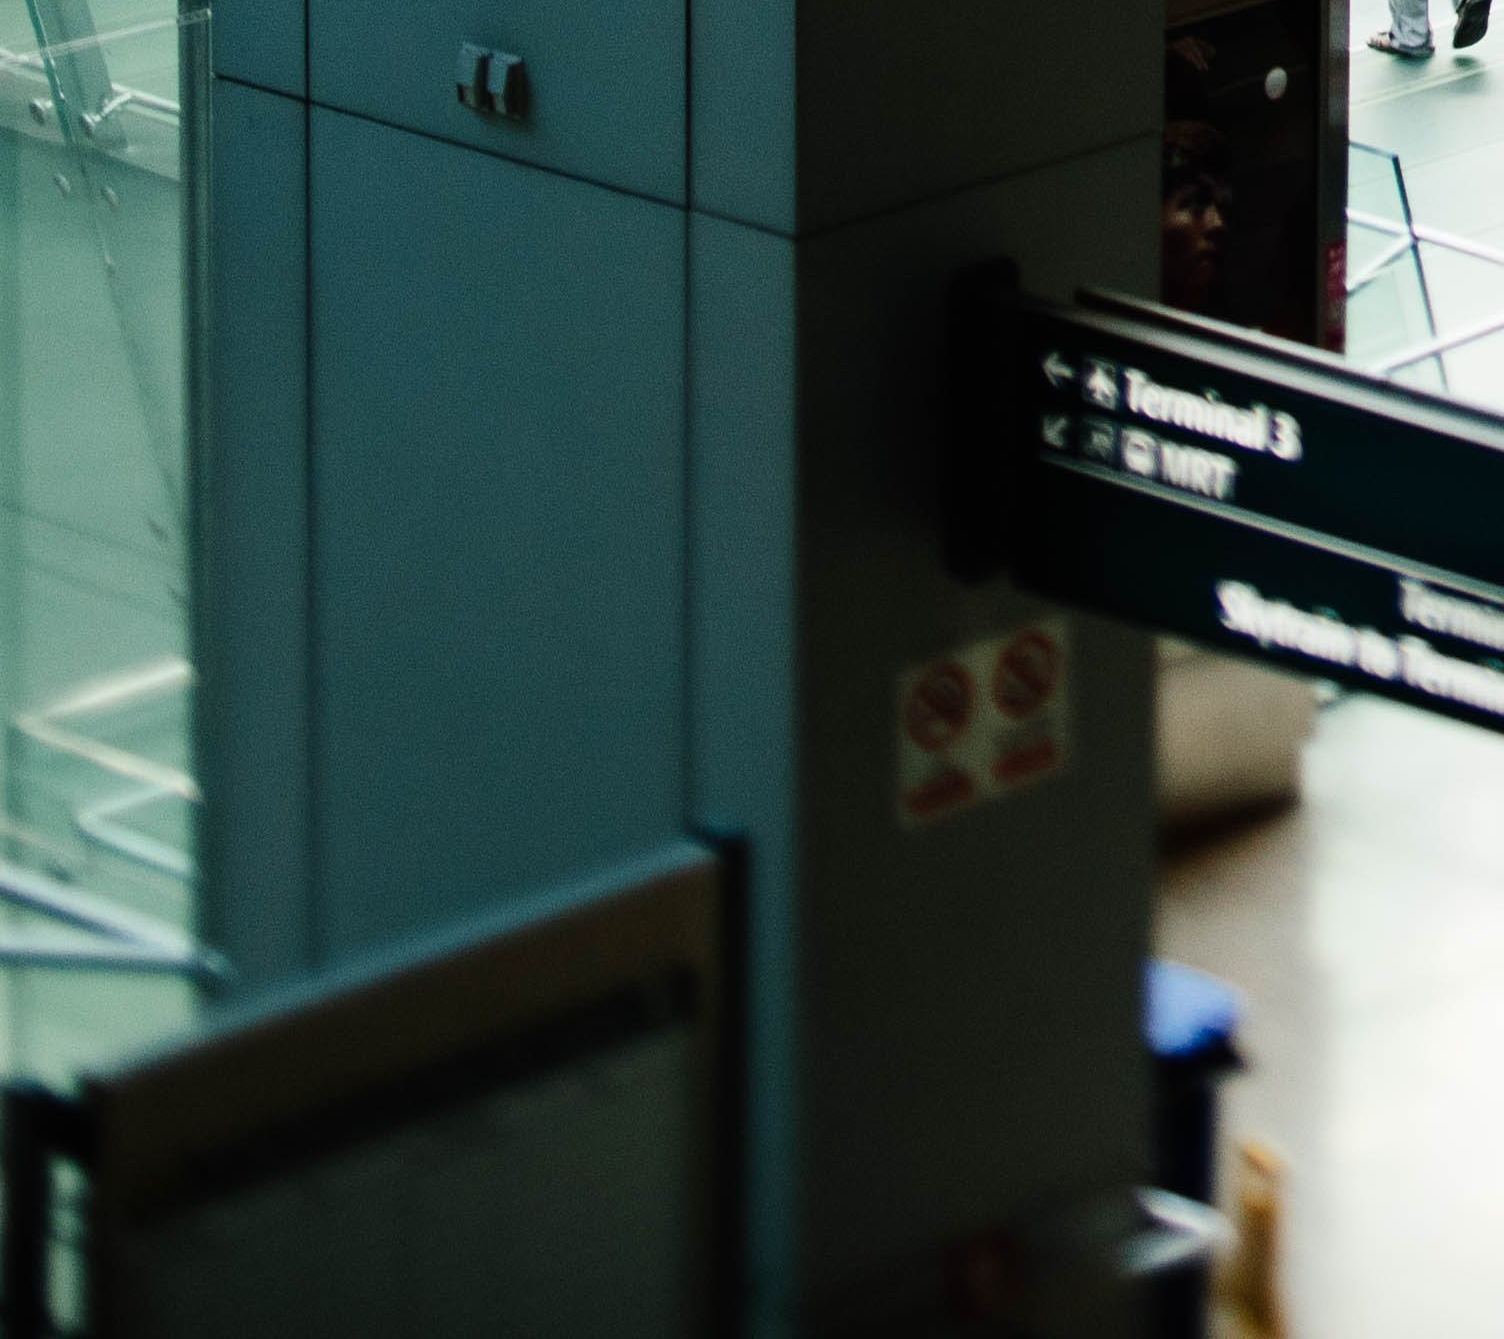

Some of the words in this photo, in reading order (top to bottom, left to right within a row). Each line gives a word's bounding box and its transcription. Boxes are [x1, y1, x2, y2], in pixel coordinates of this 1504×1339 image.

[1124, 368, 1269, 452] Terminal
[1269, 409, 1304, 462] 3
[1216, 579, 1354, 669] Skytrain
[1354, 626, 1398, 681] to
